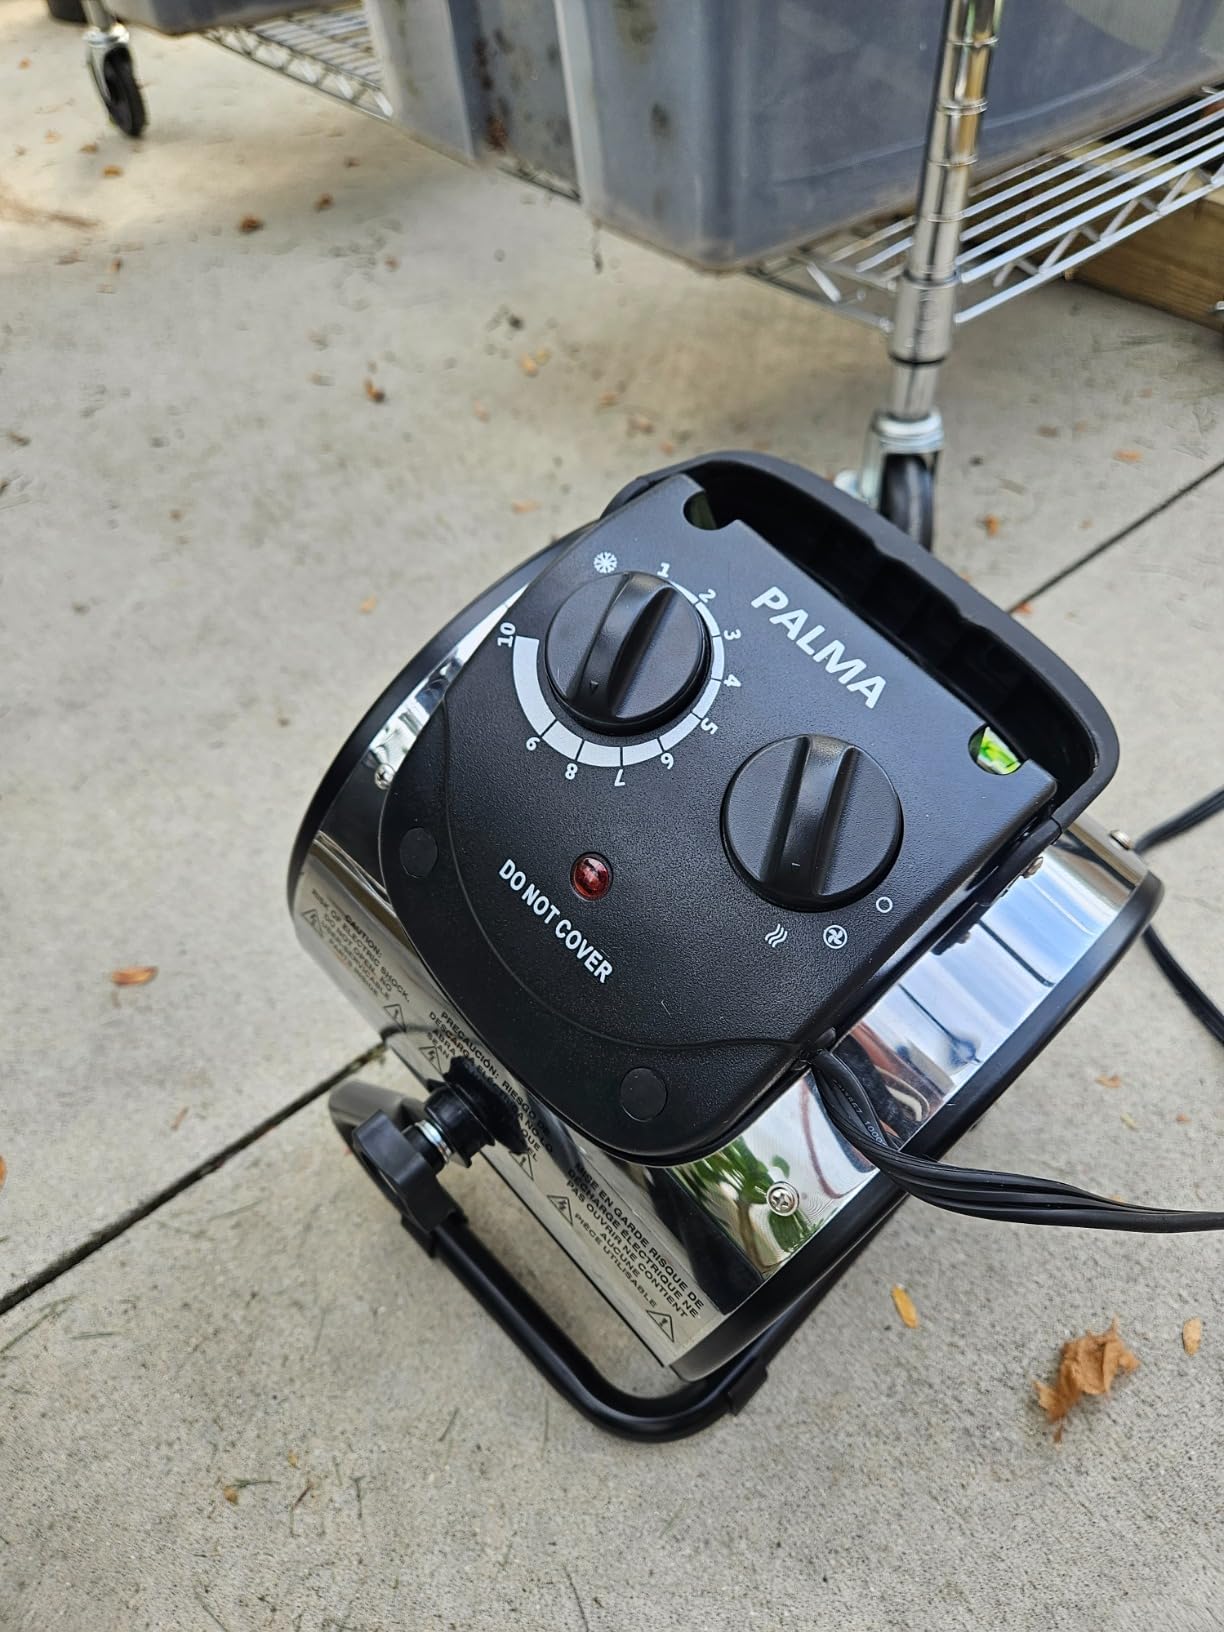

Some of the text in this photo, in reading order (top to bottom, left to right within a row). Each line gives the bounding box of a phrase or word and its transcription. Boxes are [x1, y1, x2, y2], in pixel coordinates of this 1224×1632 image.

[656, 562, 671, 578] 1
[697, 588, 717, 604] 2
[497, 622, 516, 648] 10
[723, 628, 742, 642] 3
[750, 585, 887, 709] PALMA
[723, 674, 741, 688] 4
[525, 736, 541, 752] 9
[700, 719, 718, 736] 5
[565, 763, 578, 781] 8
[614, 769, 626, 787] 7
[660, 753, 675, 770] 6
[498, 858, 614, 984] DO NOT COVER
[342, 922, 380, 967] ELECTRIC
[428, 1011, 475, 1064] DESCARGA
[524, 1118, 541, 1137] NO
[440, 1011, 500, 1080] PRECAUCIÓN:
[501, 1079, 537, 1120] RIESGO
[565, 1179, 690, 1319] PAS OUVRIR NE CONTIENT
[575, 1163, 705, 1311] MISE EN GARDE RISQUE DE
[600, 1231, 642, 1280] AUCUNE
[602, 1243, 658, 1309] UTILISABLE
[620, 1228, 684, 1301] ÉLECTRIQUE
[682, 1298, 700, 1320] NE
